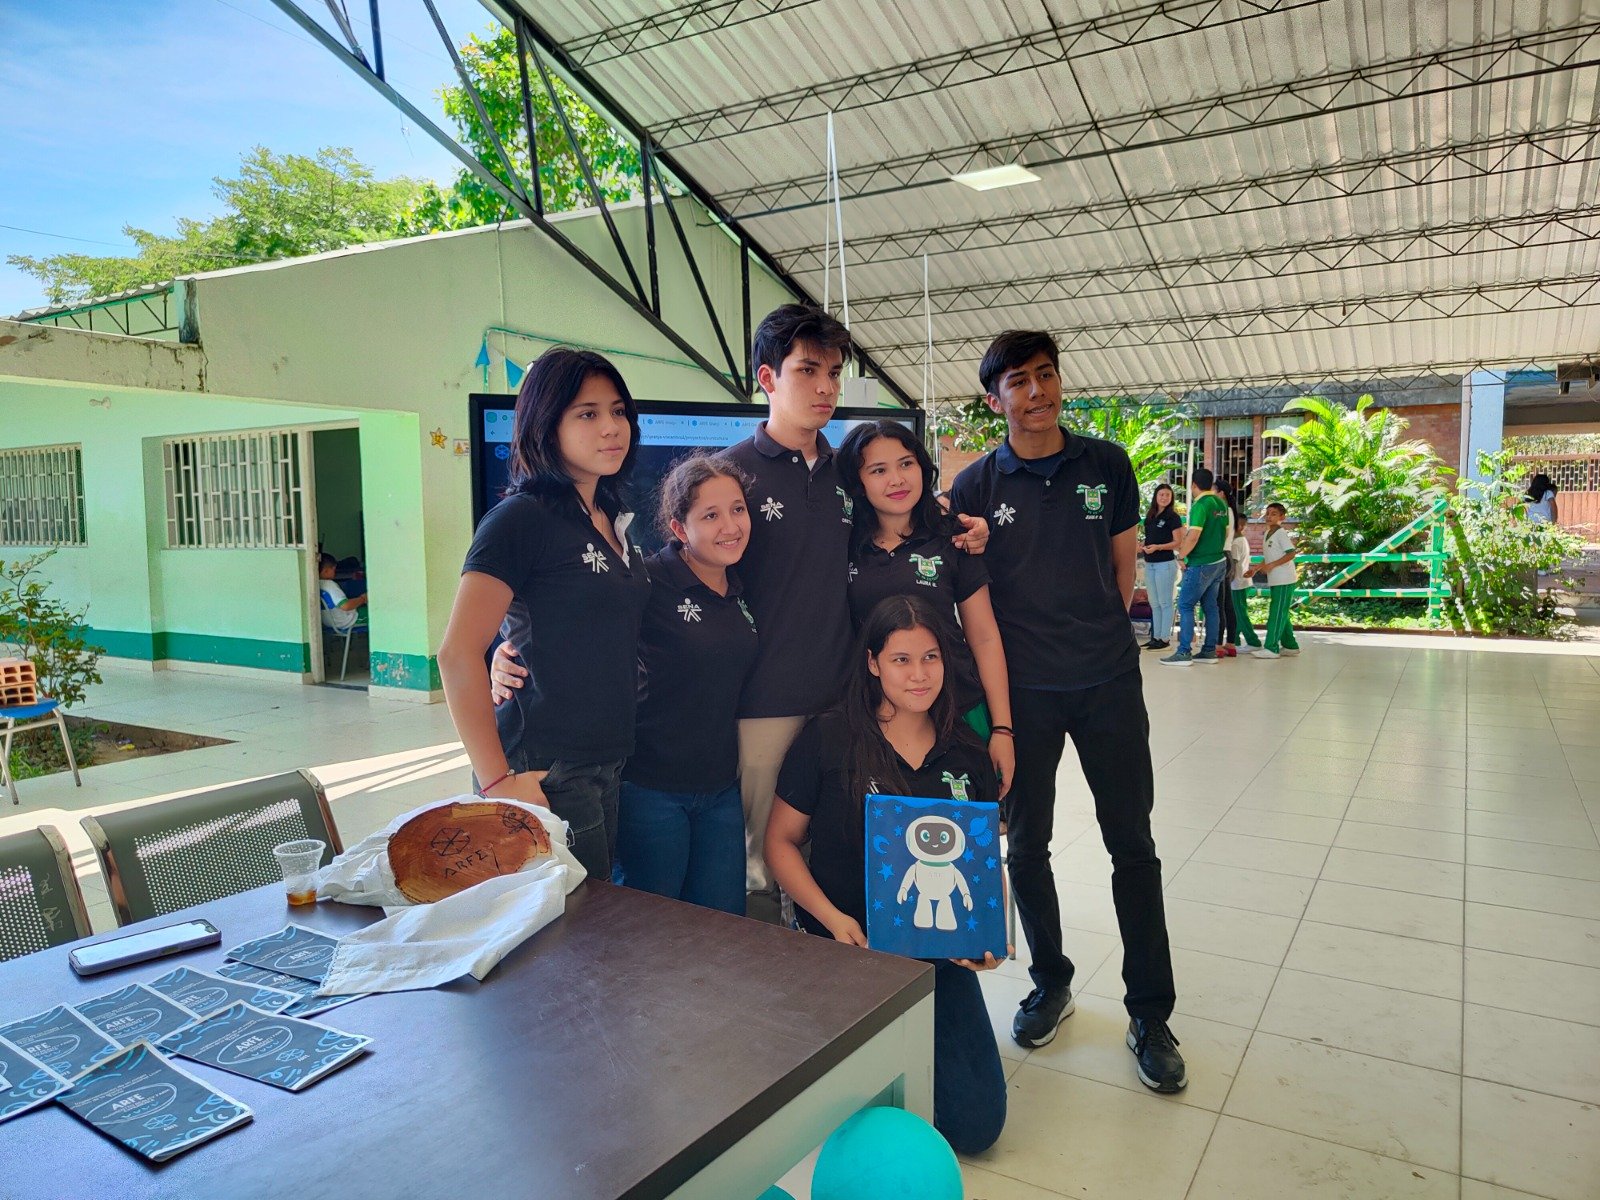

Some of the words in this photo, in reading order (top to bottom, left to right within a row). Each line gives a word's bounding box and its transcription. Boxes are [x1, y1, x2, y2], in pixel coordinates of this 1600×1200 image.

[106, 1015, 134, 1030] ARFE
[26, 1041, 52, 1054] RFE
[235, 1035, 263, 1052] ARFE
[111, 1092, 145, 1111] ARFE
